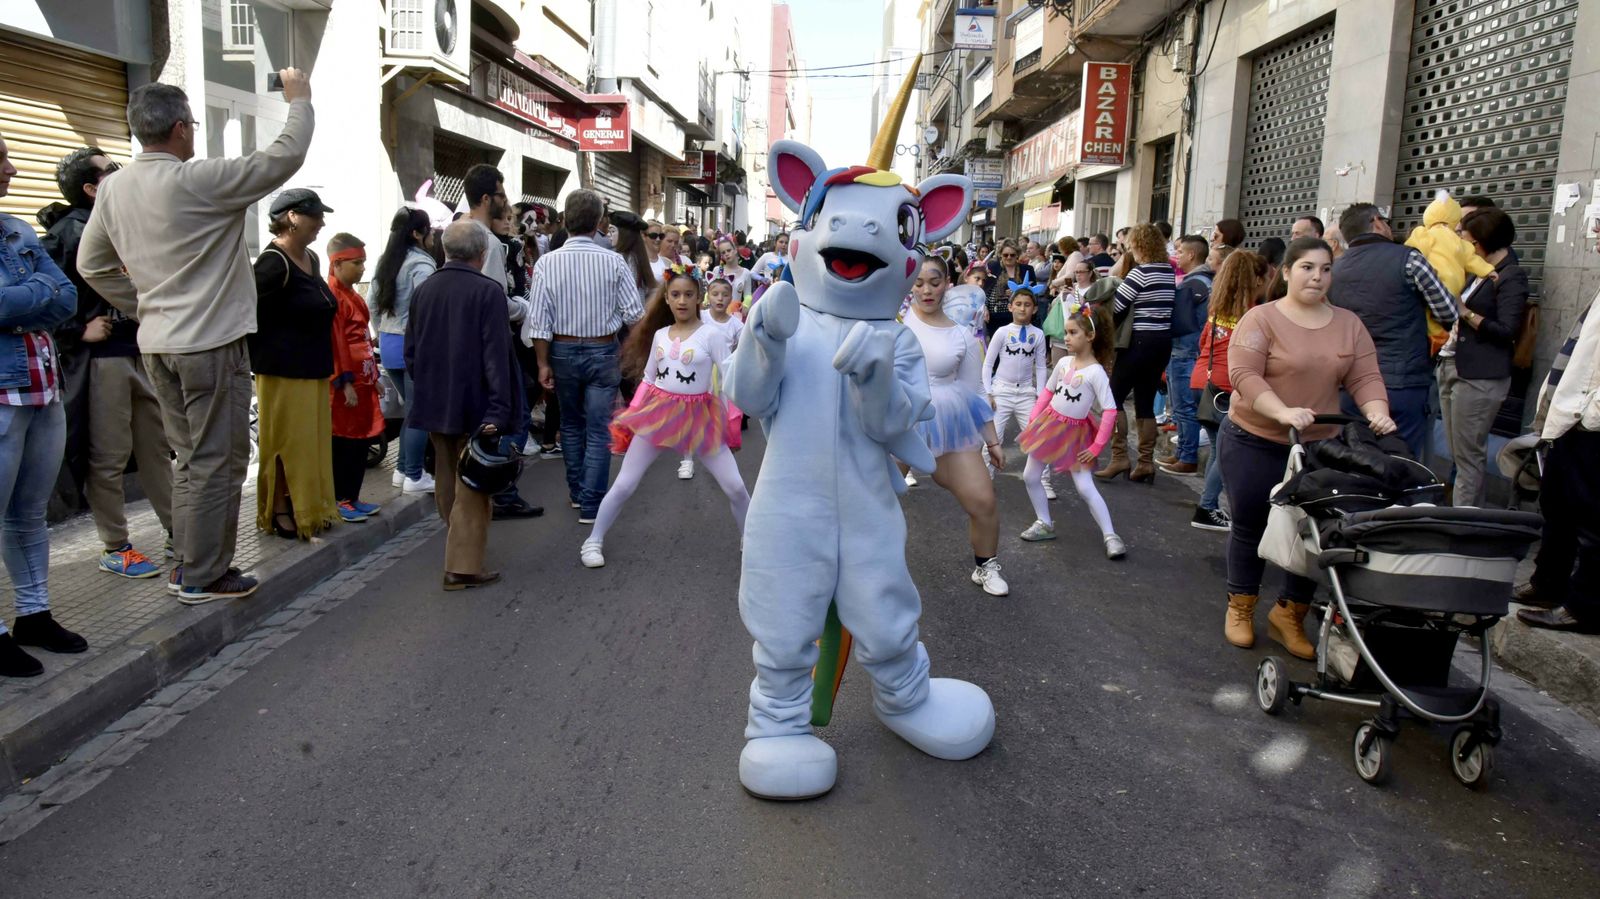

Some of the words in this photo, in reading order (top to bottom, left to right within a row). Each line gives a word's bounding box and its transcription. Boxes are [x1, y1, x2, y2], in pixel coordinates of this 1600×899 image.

[1095, 66, 1118, 139] BAZAR
[582, 129, 625, 139] GENERALI
[1010, 138, 1042, 185] BAZAR
[1048, 112, 1081, 171] CHE
[1084, 141, 1122, 153] CHEN
